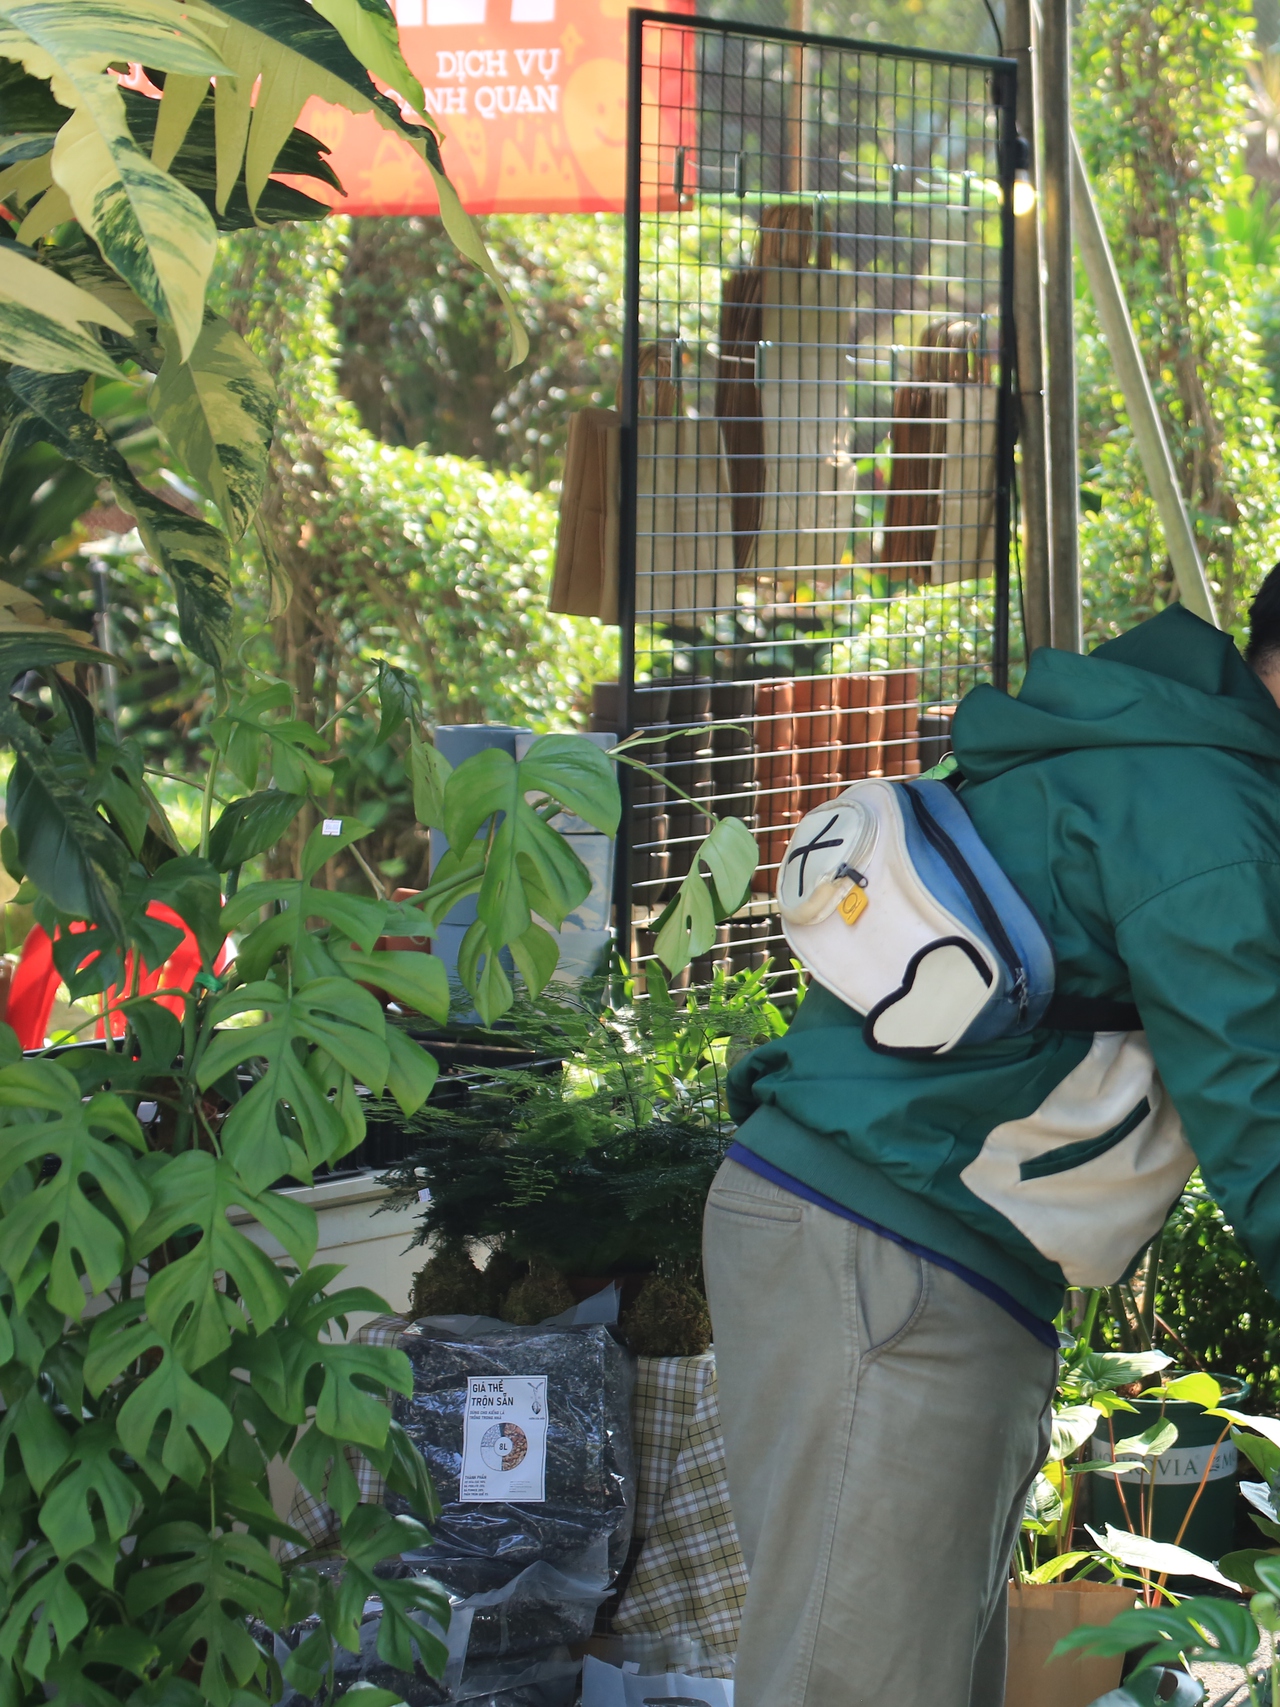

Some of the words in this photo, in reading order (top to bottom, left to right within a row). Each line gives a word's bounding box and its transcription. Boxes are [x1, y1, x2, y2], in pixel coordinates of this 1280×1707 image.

[436, 49, 508, 83] DỊCH
[514, 48, 561, 82] VỤ
[474, 85, 559, 119] QUAN
[472, 1381, 486, 1393] GIÁ
[488, 1379, 504, 1393] THỂ
[471, 1395, 494, 1408] TRỘN
[499, 1443, 508, 1451] 8L
